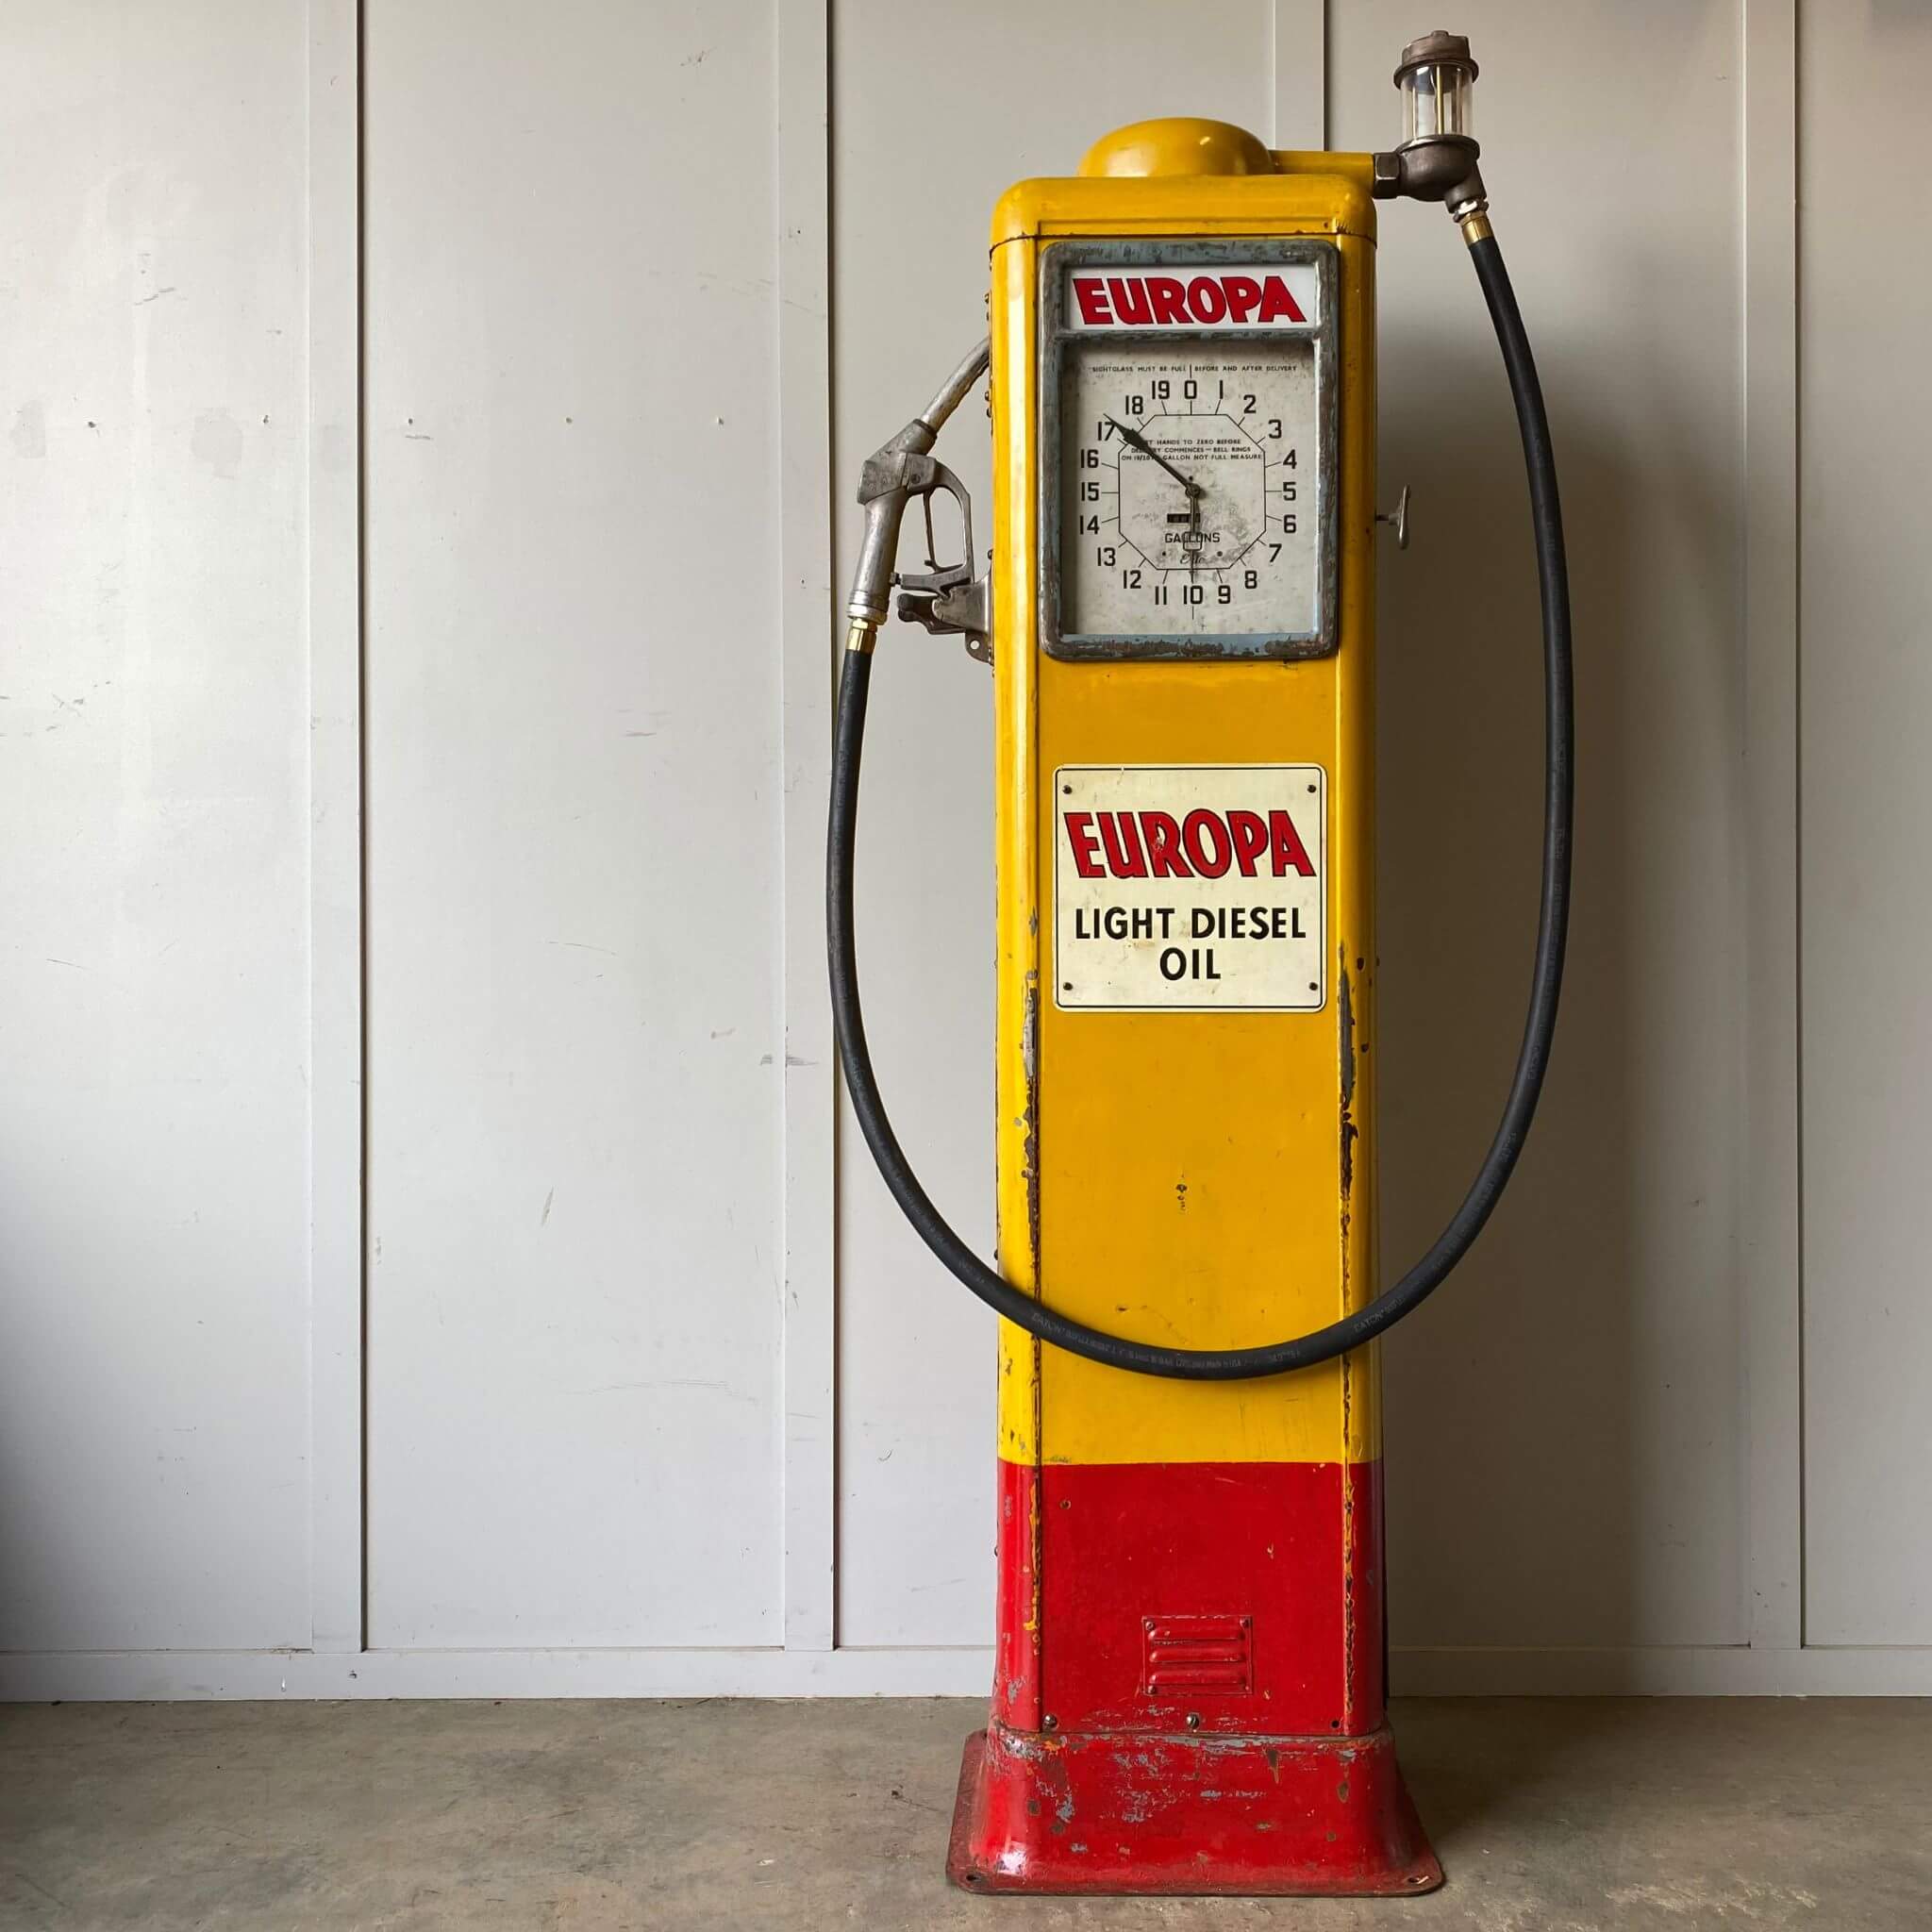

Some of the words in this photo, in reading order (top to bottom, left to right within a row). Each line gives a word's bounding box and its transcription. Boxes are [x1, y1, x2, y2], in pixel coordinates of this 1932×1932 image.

[1072, 275, 1307, 325] EUROPA
[1138, 365, 1157, 374] MUST
[1151, 380, 1171, 400] 19
[1184, 380, 1197, 400] 0
[1218, 379, 1224, 399] 1
[1124, 395, 1144, 415] 18
[1243, 394, 1257, 414] 2
[1097, 422, 1117, 441] 17
[1268, 419, 1282, 439] 3
[1079, 450, 1100, 470] 16
[1282, 449, 1298, 469] 4
[1079, 482, 1100, 502] 15
[1282, 482, 1297, 501] 5
[1079, 514, 1100, 534] 14
[1282, 514, 1297, 534] 6
[1096, 546, 1117, 567] 13
[1269, 543, 1282, 563] 7
[1123, 570, 1142, 590] 12
[1244, 570, 1257, 590] 8
[1155, 585, 1168, 606] 11
[1183, 585, 1204, 605] 10
[1218, 585, 1231, 605] 9
[1063, 808, 1317, 879] EUROPA
[1075, 907, 1175, 940] LIGHT
[1191, 907, 1306, 940] DIESEL
[1159, 947, 1221, 981] OIL
